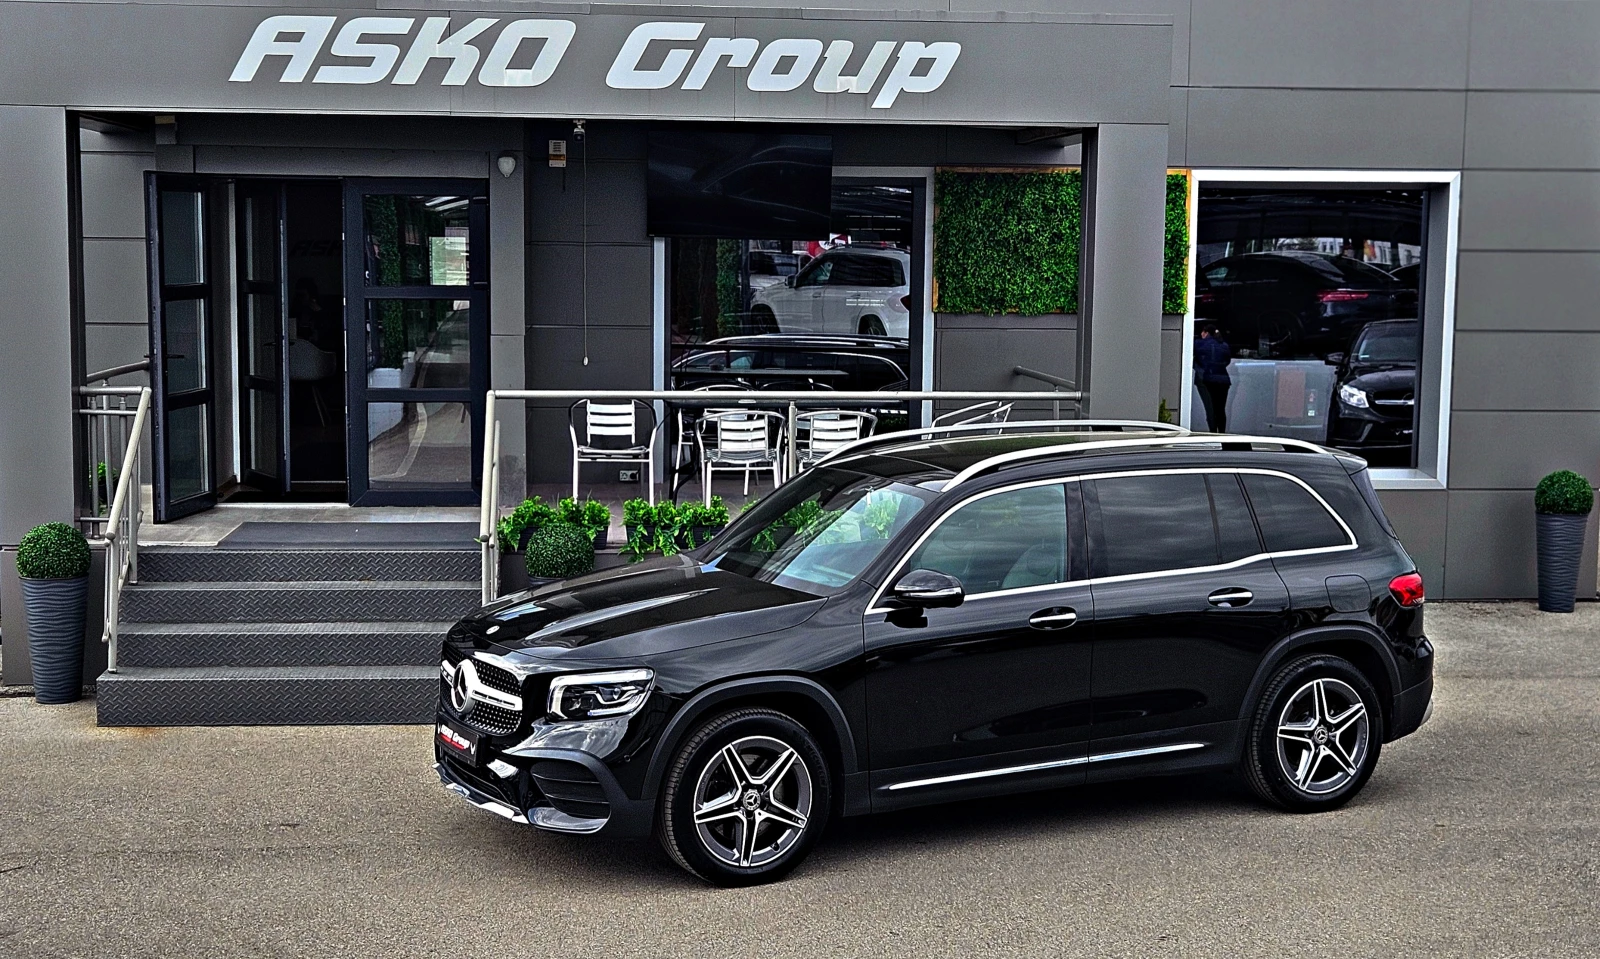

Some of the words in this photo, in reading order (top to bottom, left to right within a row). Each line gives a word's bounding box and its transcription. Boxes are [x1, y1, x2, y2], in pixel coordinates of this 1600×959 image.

[228, 15, 577, 87] ASKO
[605, 22, 962, 109] Group
[290, 239, 342, 256] ASK
